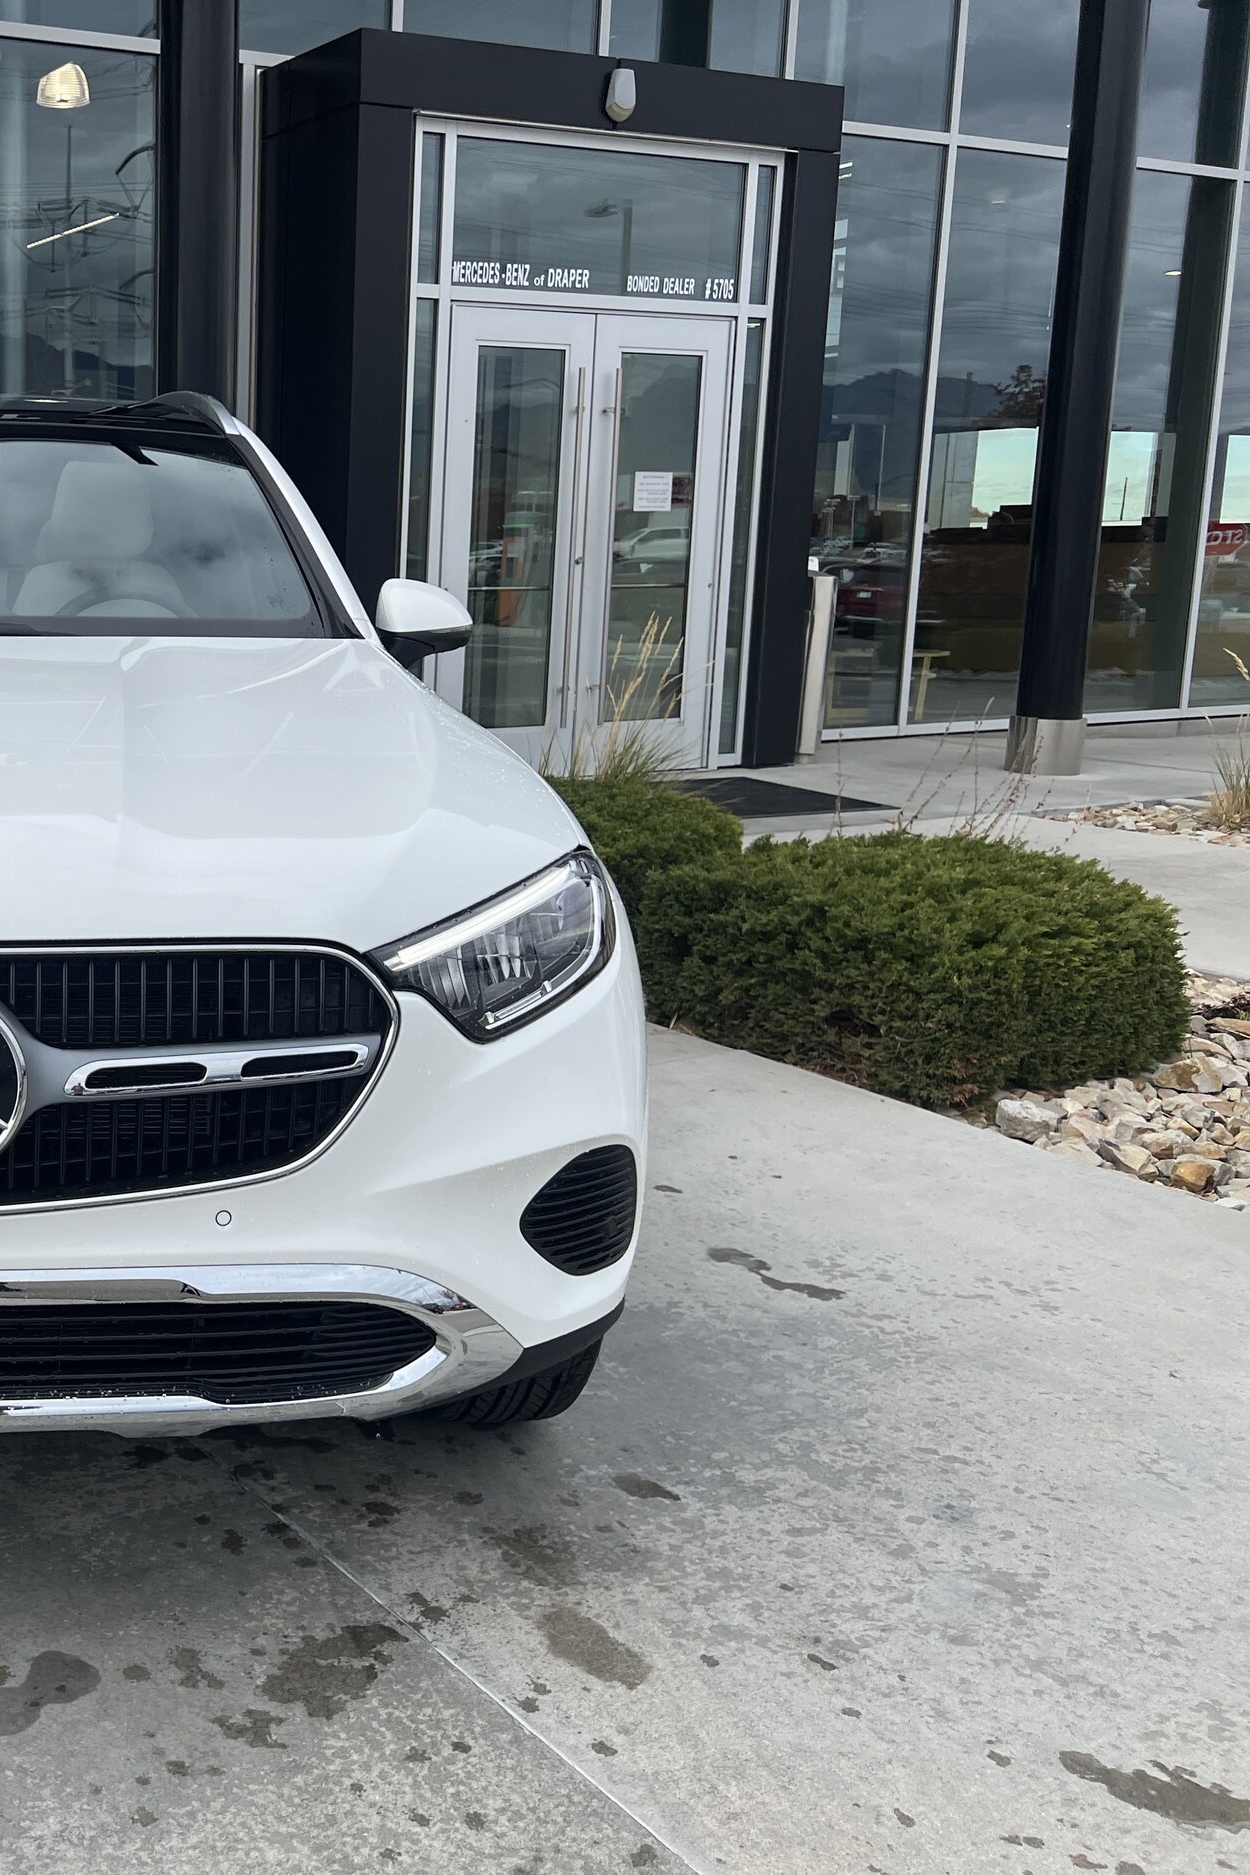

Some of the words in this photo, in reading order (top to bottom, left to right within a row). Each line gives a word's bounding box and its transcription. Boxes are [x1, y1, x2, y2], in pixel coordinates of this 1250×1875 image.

[533, 274, 545, 287] of
[547, 268, 590, 289] DRAPER
[626, 274, 660, 293] BONDED
[662, 277, 696, 295] DEALER
